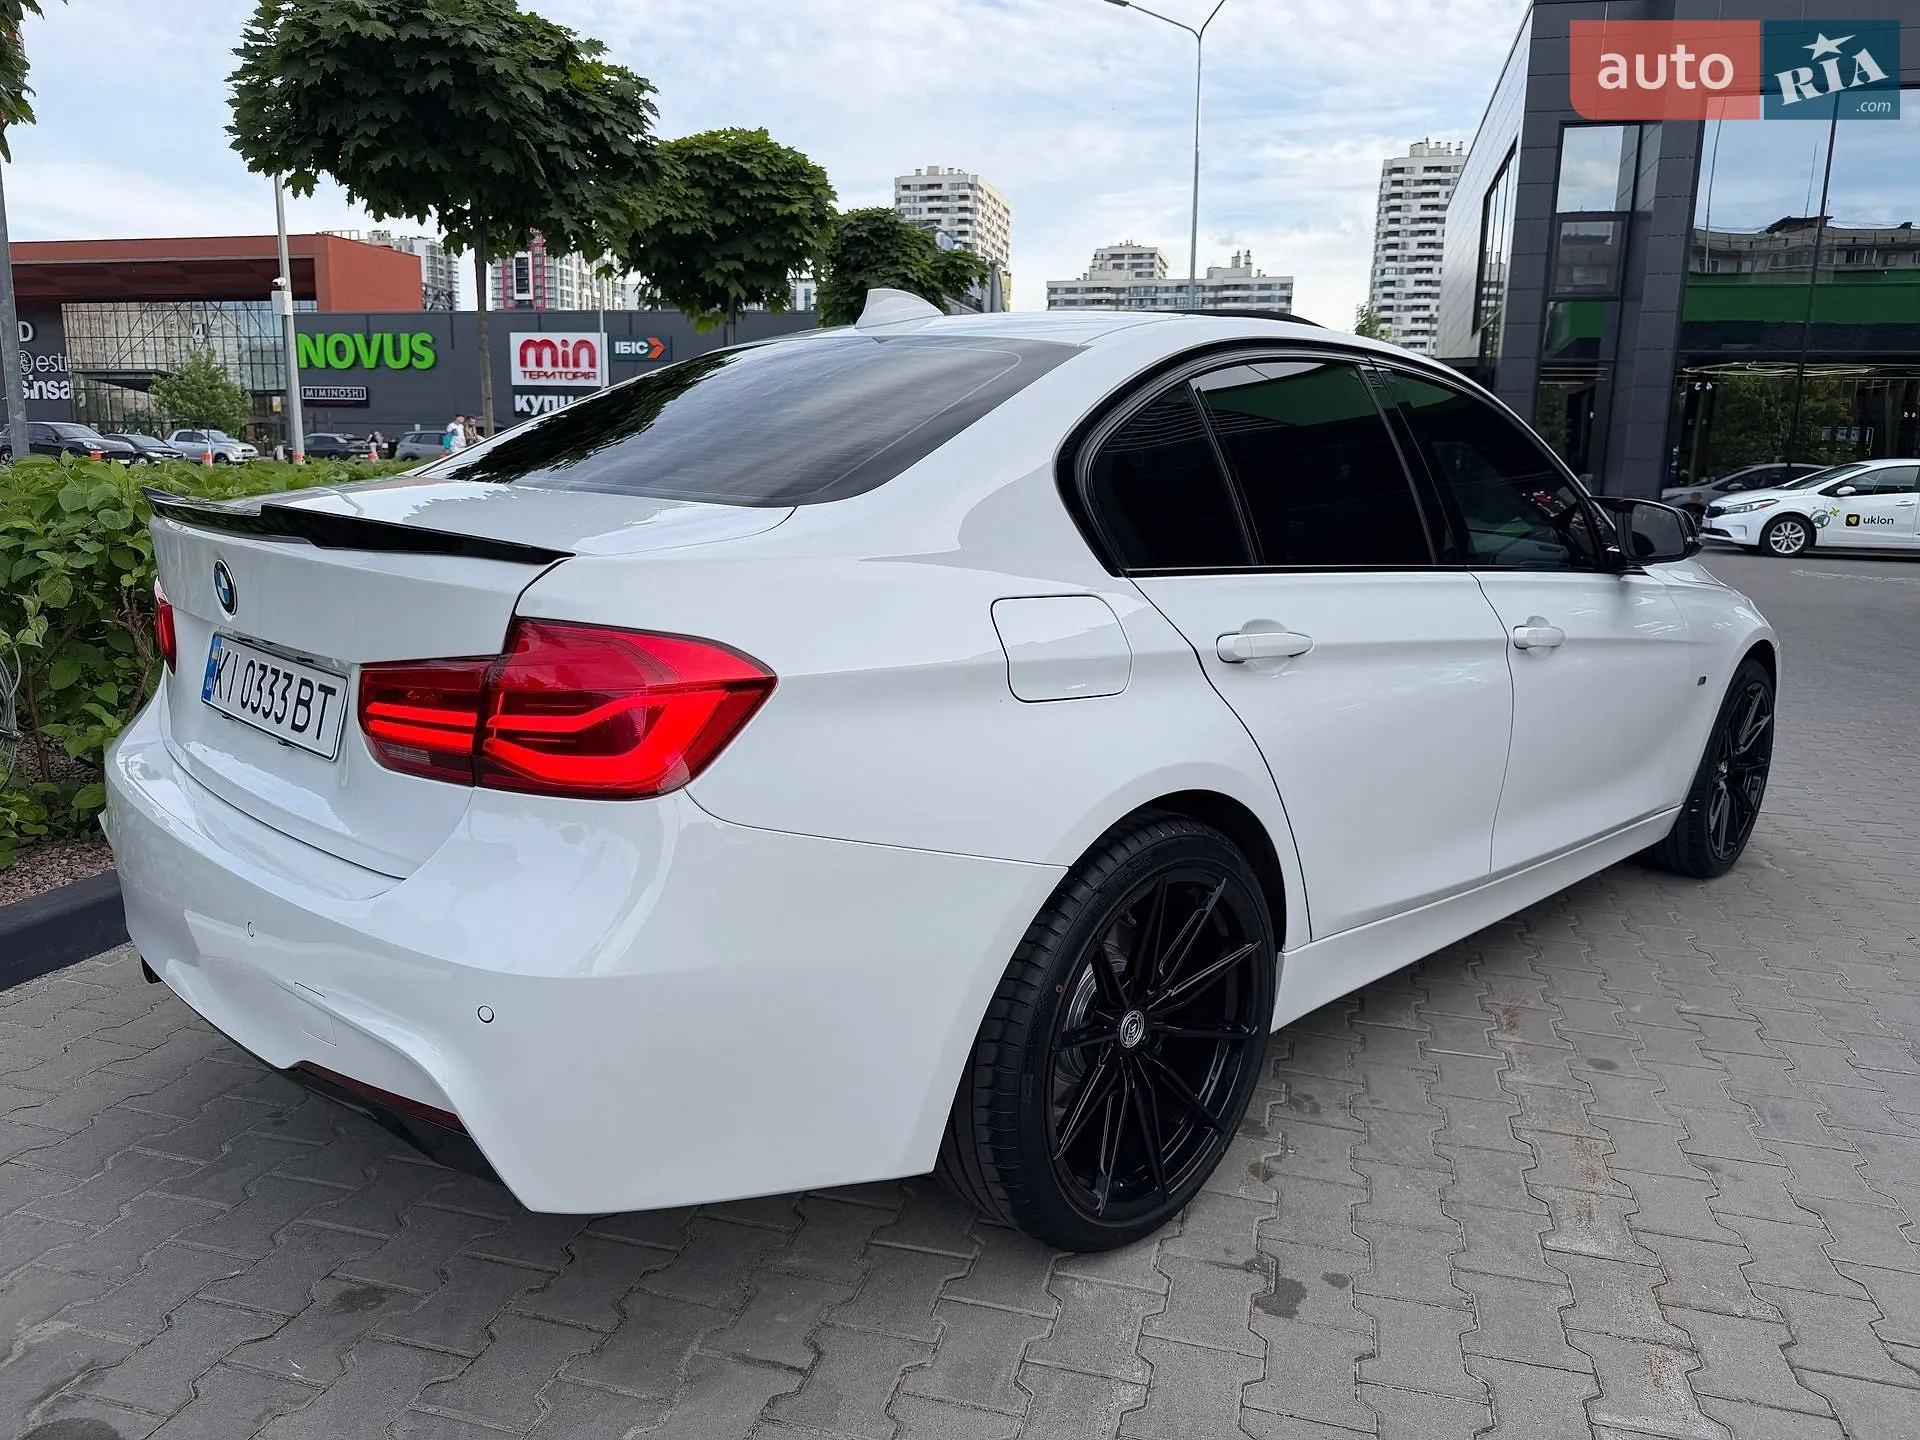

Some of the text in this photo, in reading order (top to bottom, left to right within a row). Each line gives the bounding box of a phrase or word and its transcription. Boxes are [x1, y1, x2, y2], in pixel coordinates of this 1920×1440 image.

[296, 332, 435, 369] NOVUS
[615, 341, 648, 354] ІБІС
[305, 388, 363, 398] MIMINOSHI
[1863, 515, 1894, 525] uklon
[212, 647, 337, 741] KI 0333 BT
